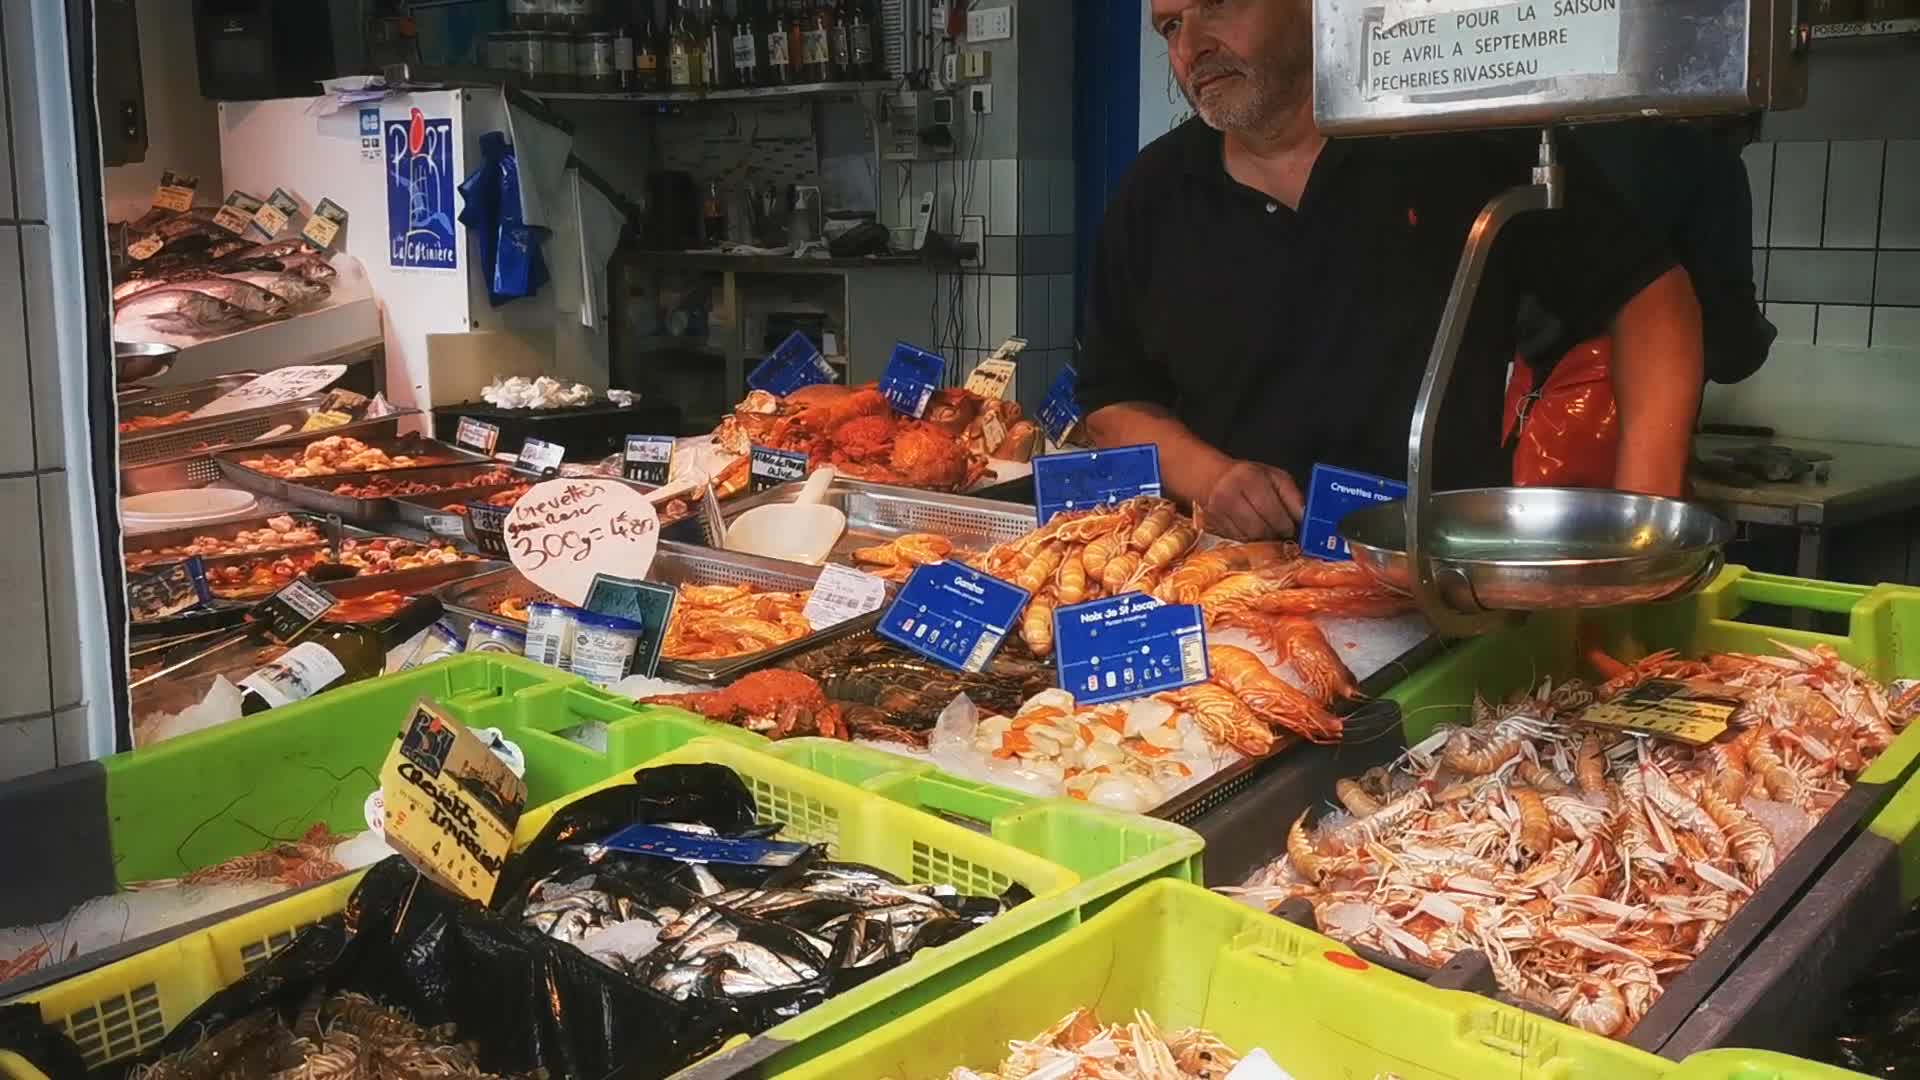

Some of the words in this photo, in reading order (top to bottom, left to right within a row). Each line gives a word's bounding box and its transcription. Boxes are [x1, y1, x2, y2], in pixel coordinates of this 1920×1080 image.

[1456, 9, 1500, 30] POUR
[1517, 5, 1536, 22] LA
[1553, 0, 1616, 18] SAISON
[1373, 50, 1391, 67] DE
[1402, 44, 1445, 63] AVRIL
[1452, 41, 1463, 57] A
[1475, 27, 1568, 54] SEPTEMBRE
[1373, 68, 1450, 91] PECHERIES
[1453, 59, 1538, 83] RIVASSEAU
[1080, 610, 1103, 624] Noix
